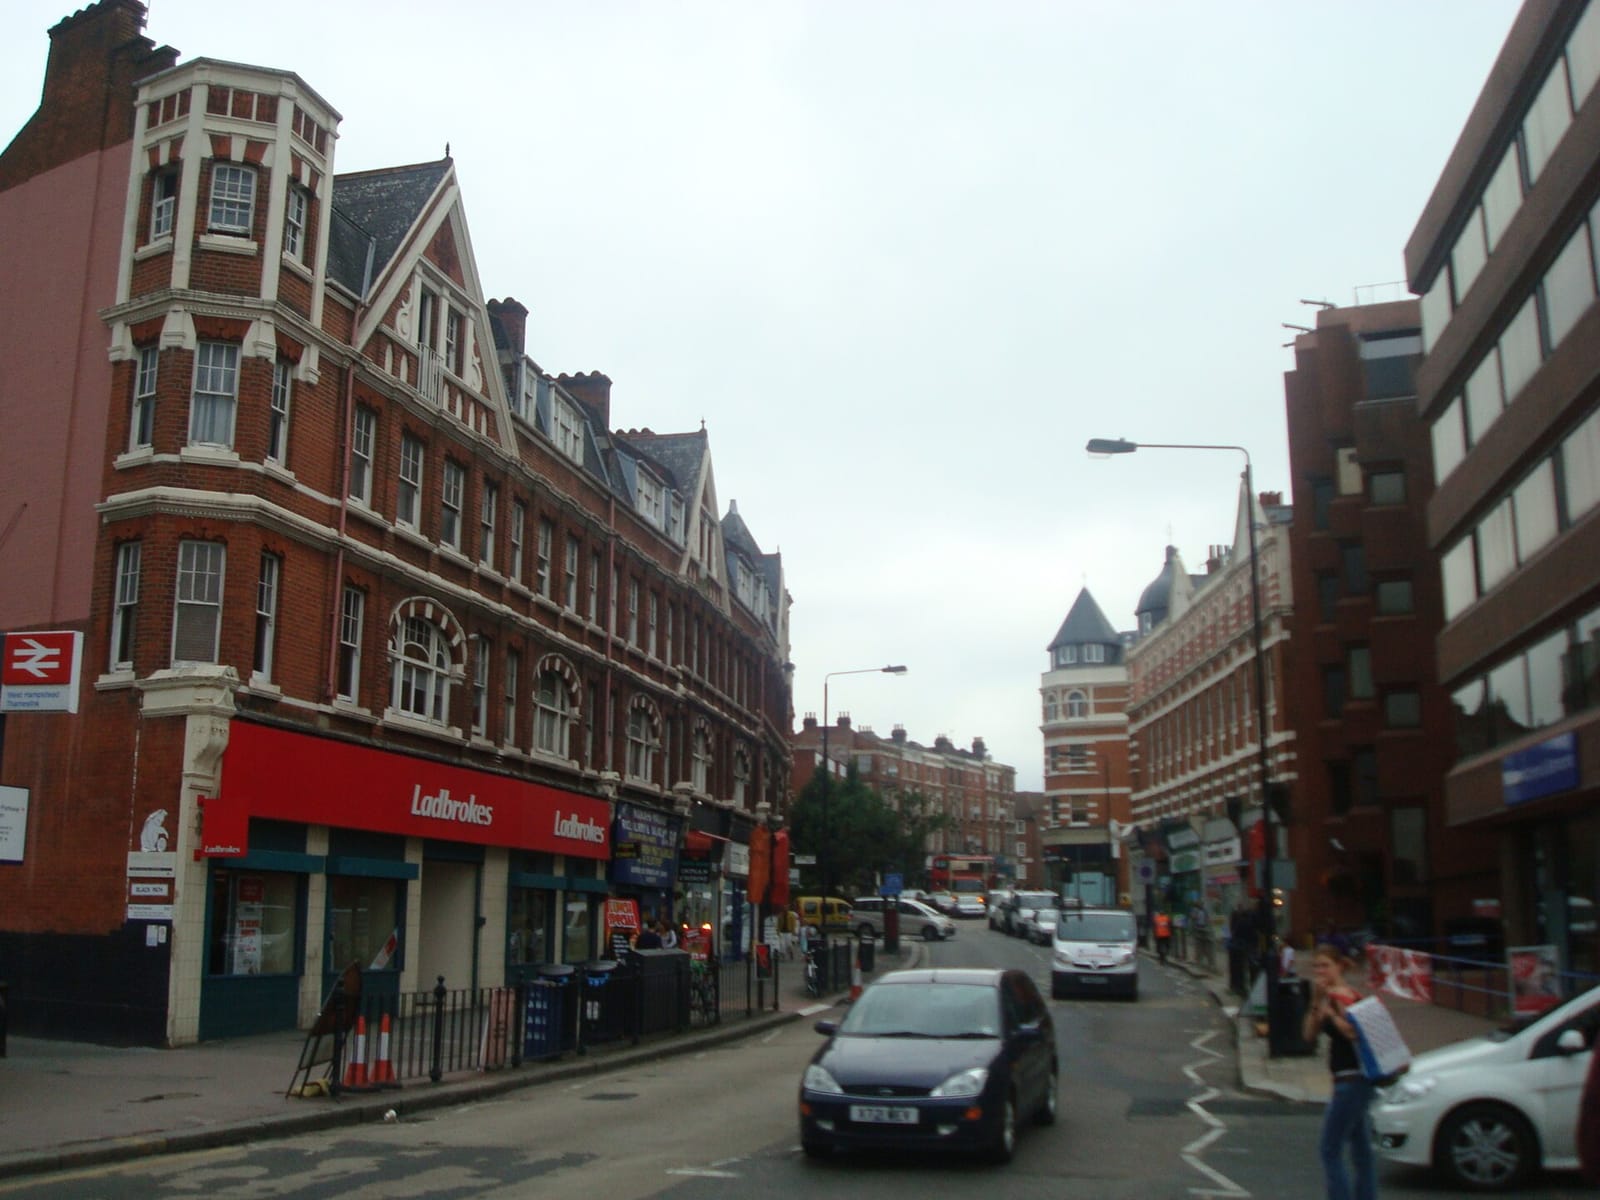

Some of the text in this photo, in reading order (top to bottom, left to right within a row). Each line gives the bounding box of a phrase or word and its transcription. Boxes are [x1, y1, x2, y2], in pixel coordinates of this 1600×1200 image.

[411, 784, 493, 826] Ladbrokes
[553, 810, 605, 843] Ladbrokes
[204, 844, 241, 853] Ladbrokes
